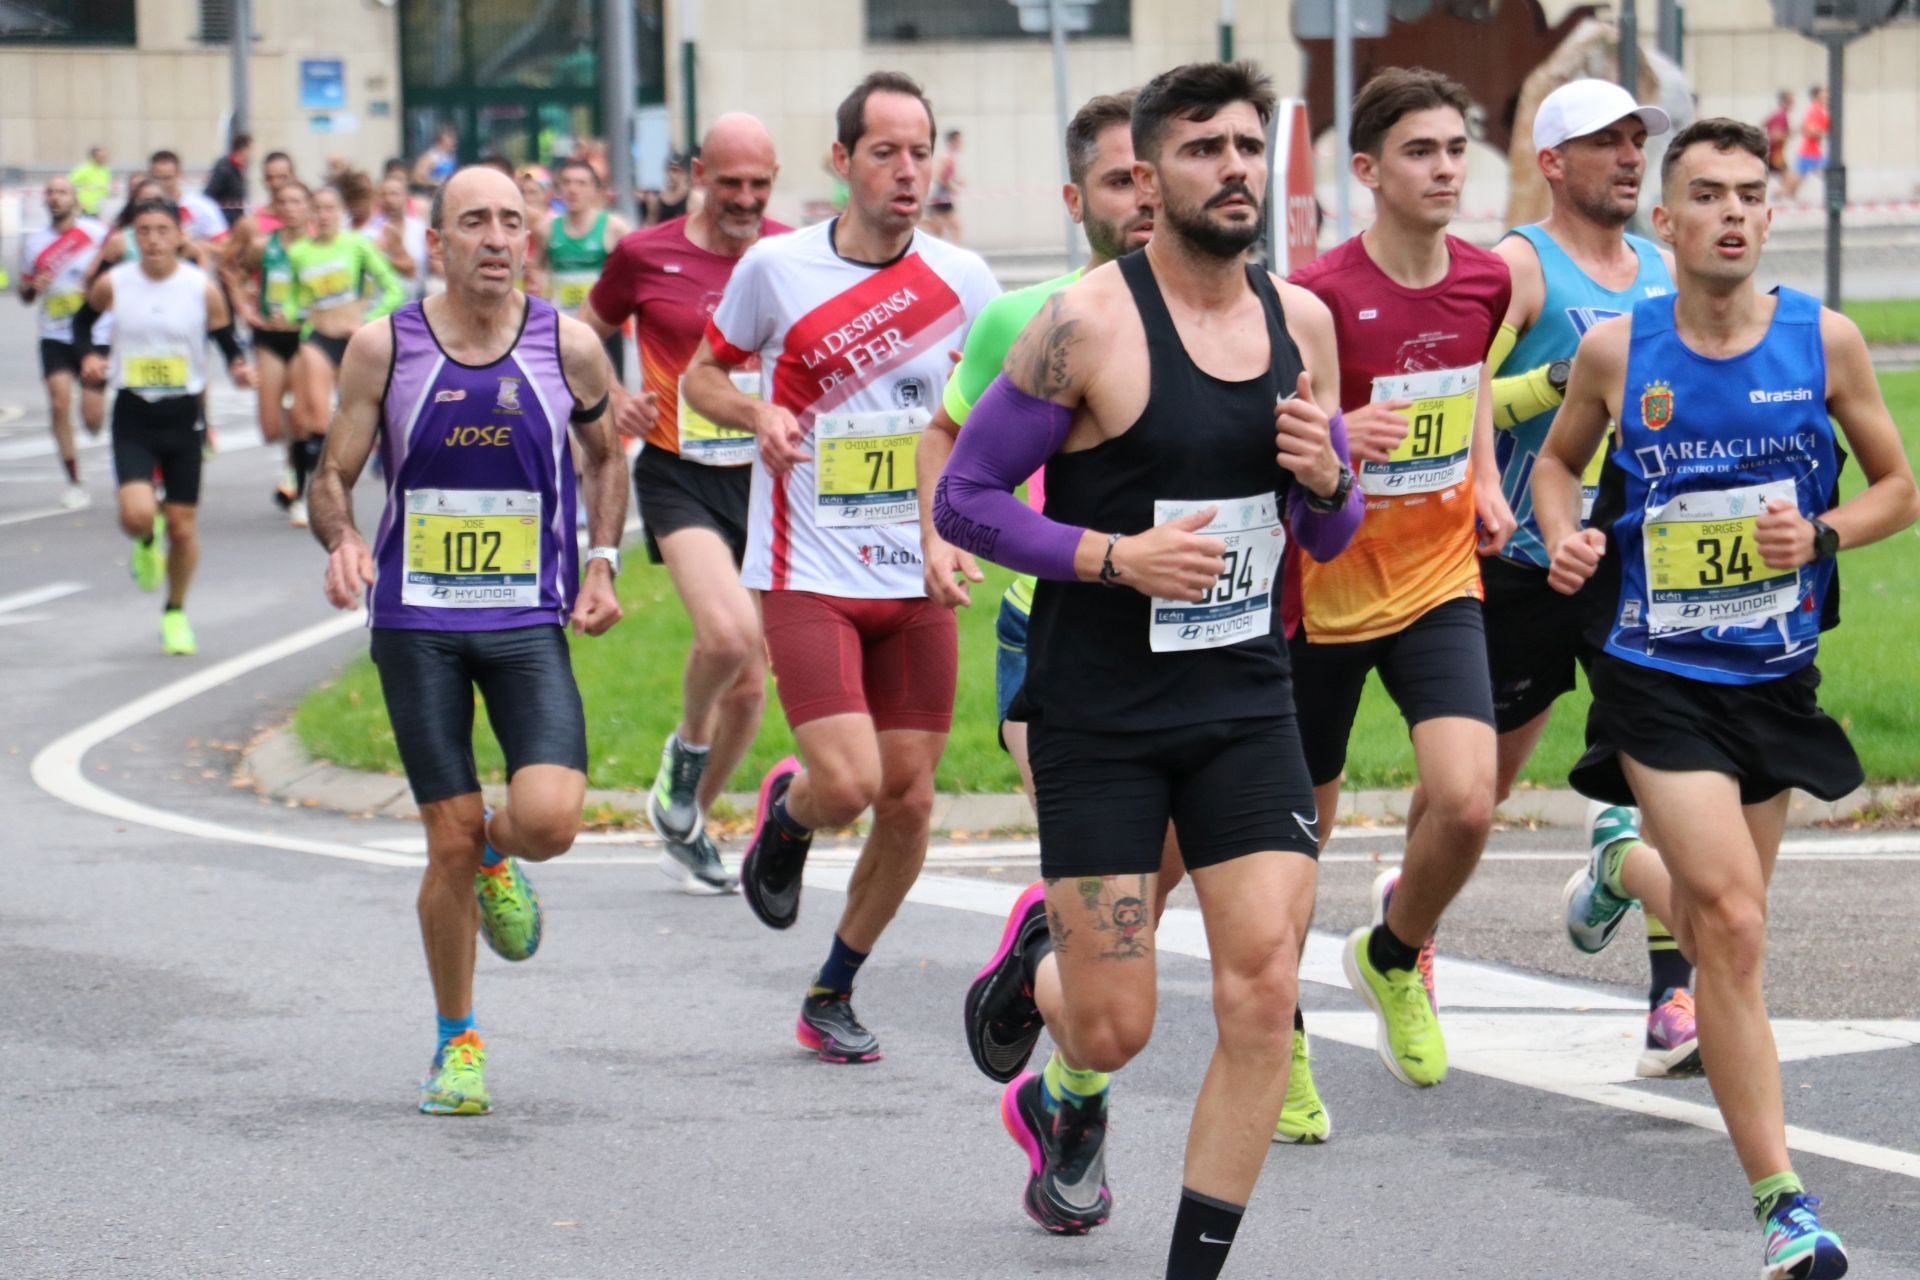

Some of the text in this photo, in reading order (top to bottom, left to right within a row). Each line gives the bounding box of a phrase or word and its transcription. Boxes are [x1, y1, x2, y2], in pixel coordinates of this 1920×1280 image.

[1288, 195, 1315, 248] STOP
[801, 287, 918, 369] LA DESPENSA
[818, 328, 914, 394] DE FER
[1767, 387, 1812, 402] rasán
[1418, 400, 1445, 411] CESAR
[445, 426, 512, 446] JOSE
[1411, 412, 1444, 457] 91
[865, 450, 893, 491] 71
[1407, 468, 1455, 484] HYUNDAI
[1677, 465, 1714, 473] CENTRO
[1717, 464, 1731, 473] DE
[864, 502, 916, 517] HYUNDAI
[461, 519, 485, 529] JOSE
[1702, 522, 1743, 536] BORGES
[443, 532, 502, 572] 102
[1697, 536, 1752, 586] 34
[1191, 547, 1252, 605] 94
[455, 588, 516, 599] HYUNDAI
[1709, 594, 1776, 615] HYUNDAI
[1206, 615, 1253, 635] HYUNDAI
